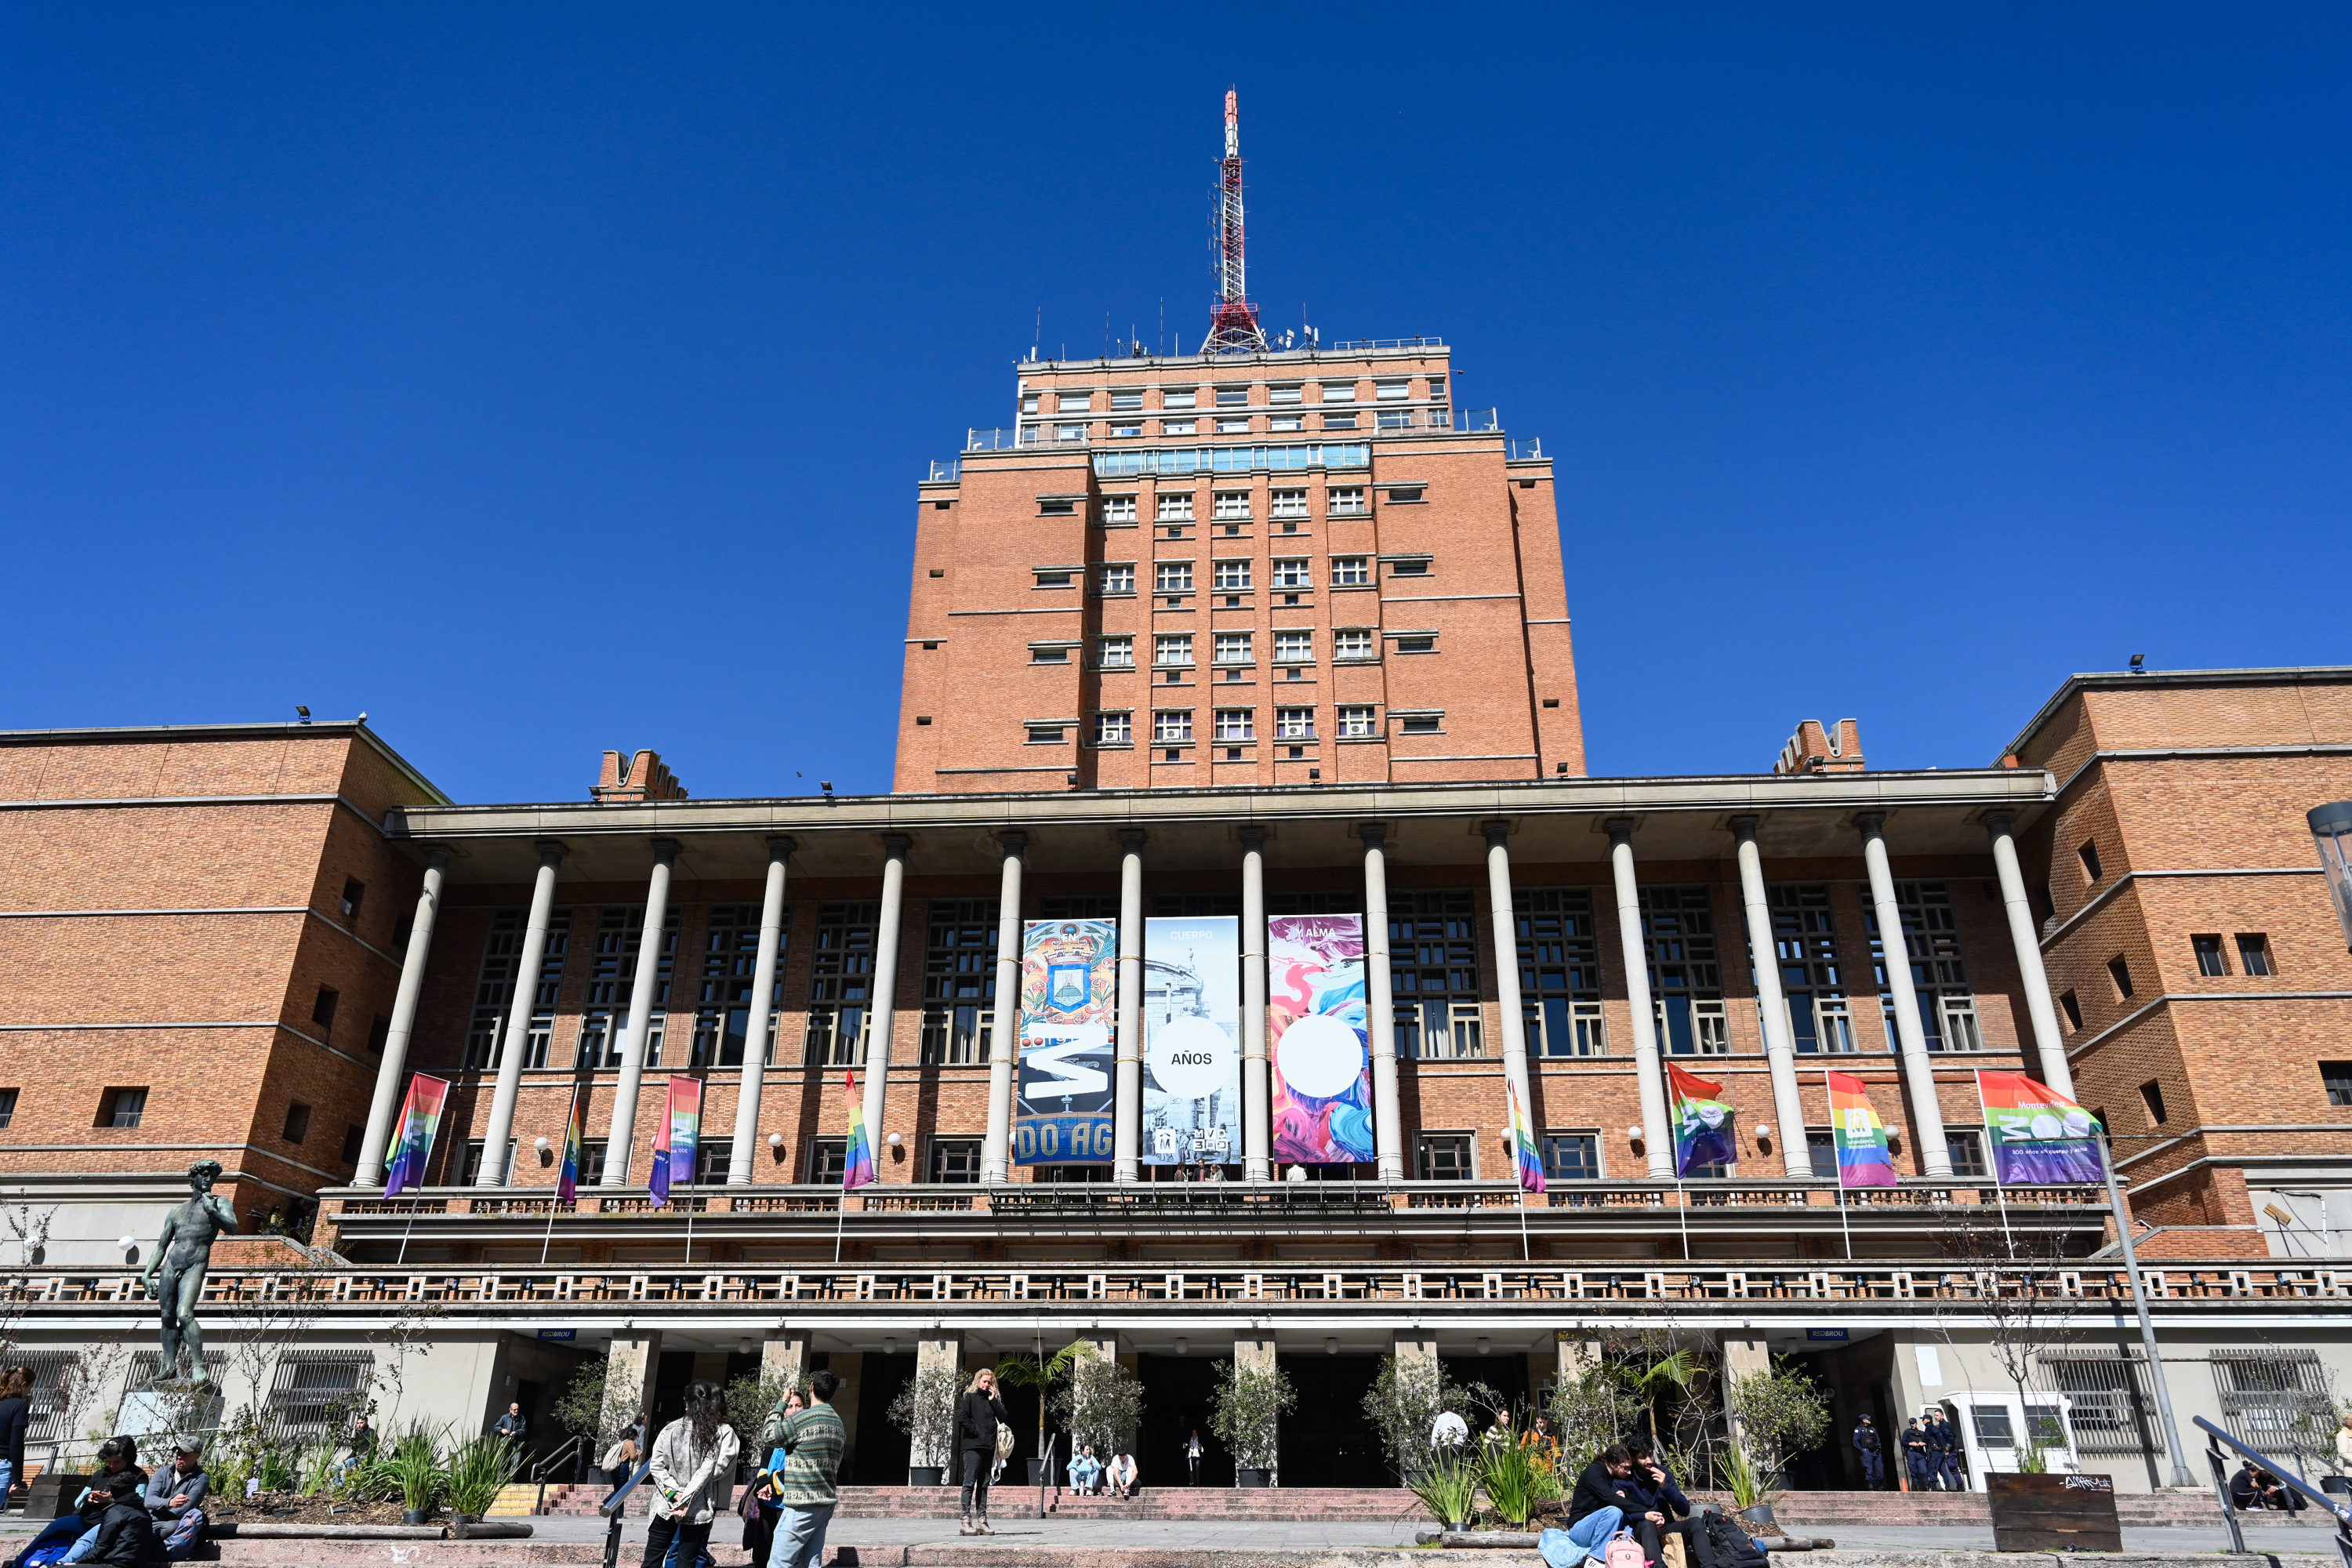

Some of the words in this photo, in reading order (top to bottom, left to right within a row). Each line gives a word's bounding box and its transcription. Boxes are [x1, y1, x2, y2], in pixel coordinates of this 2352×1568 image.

[1171, 931, 1213, 940] CUERPO
[1305, 928, 1336, 937] ALMA
[1062, 933, 1077, 942] EN
[1171, 1050, 1212, 1065] AÑOS
[2018, 1100, 2065, 1109] Montevideo
[1017, 1123, 1058, 1159] DO
